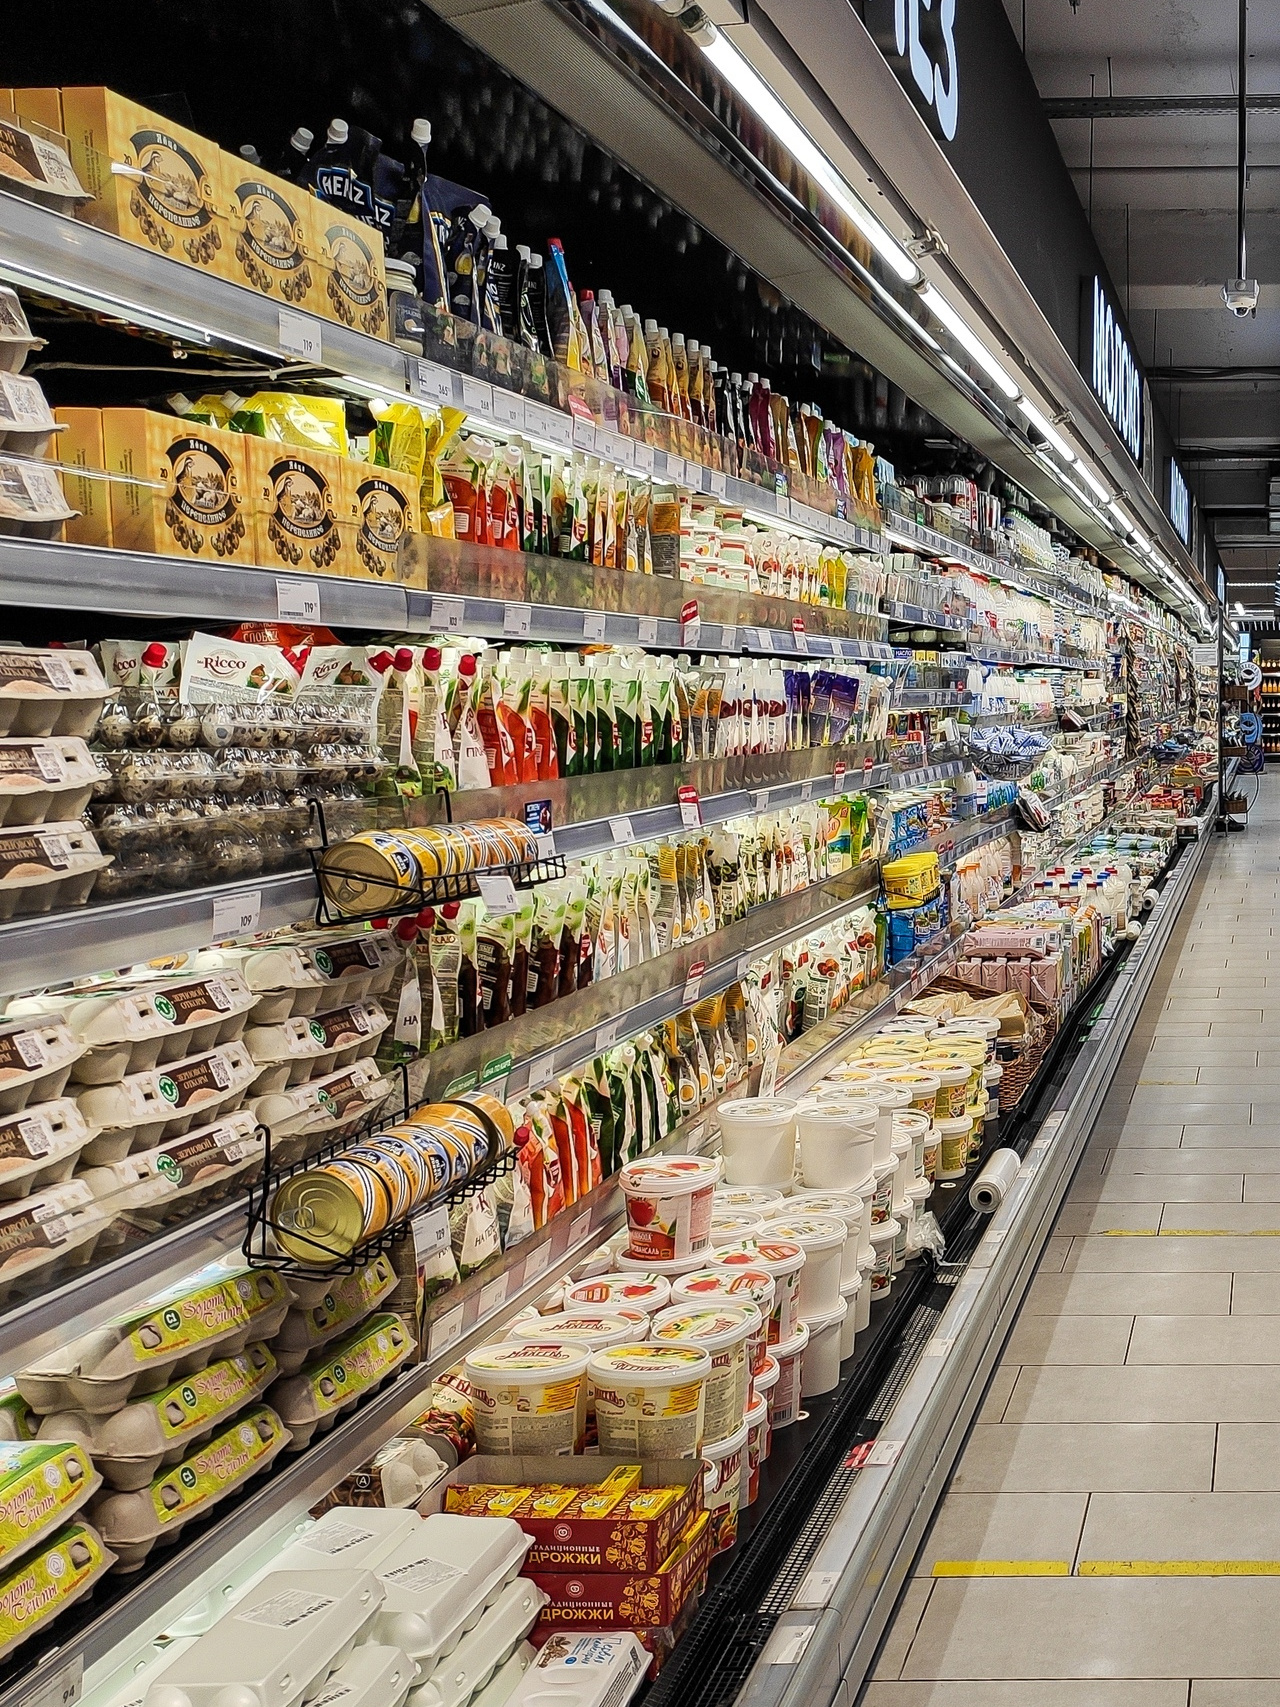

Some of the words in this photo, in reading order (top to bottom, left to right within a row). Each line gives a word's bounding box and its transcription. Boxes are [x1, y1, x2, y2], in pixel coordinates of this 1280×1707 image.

[302, 339, 313, 351] 119
[303, 601, 314, 613] 119
[203, 655, 247, 670] Ricco
[239, 914, 252, 928] 109
[528, 1552, 601, 1566] ДРОЖЖИ
[546, 1600, 613, 1608] АДИЦИОННЫЕ
[540, 1608, 614, 1622] ДРОЖЖИ
[62, 1684, 75, 1703] 94
